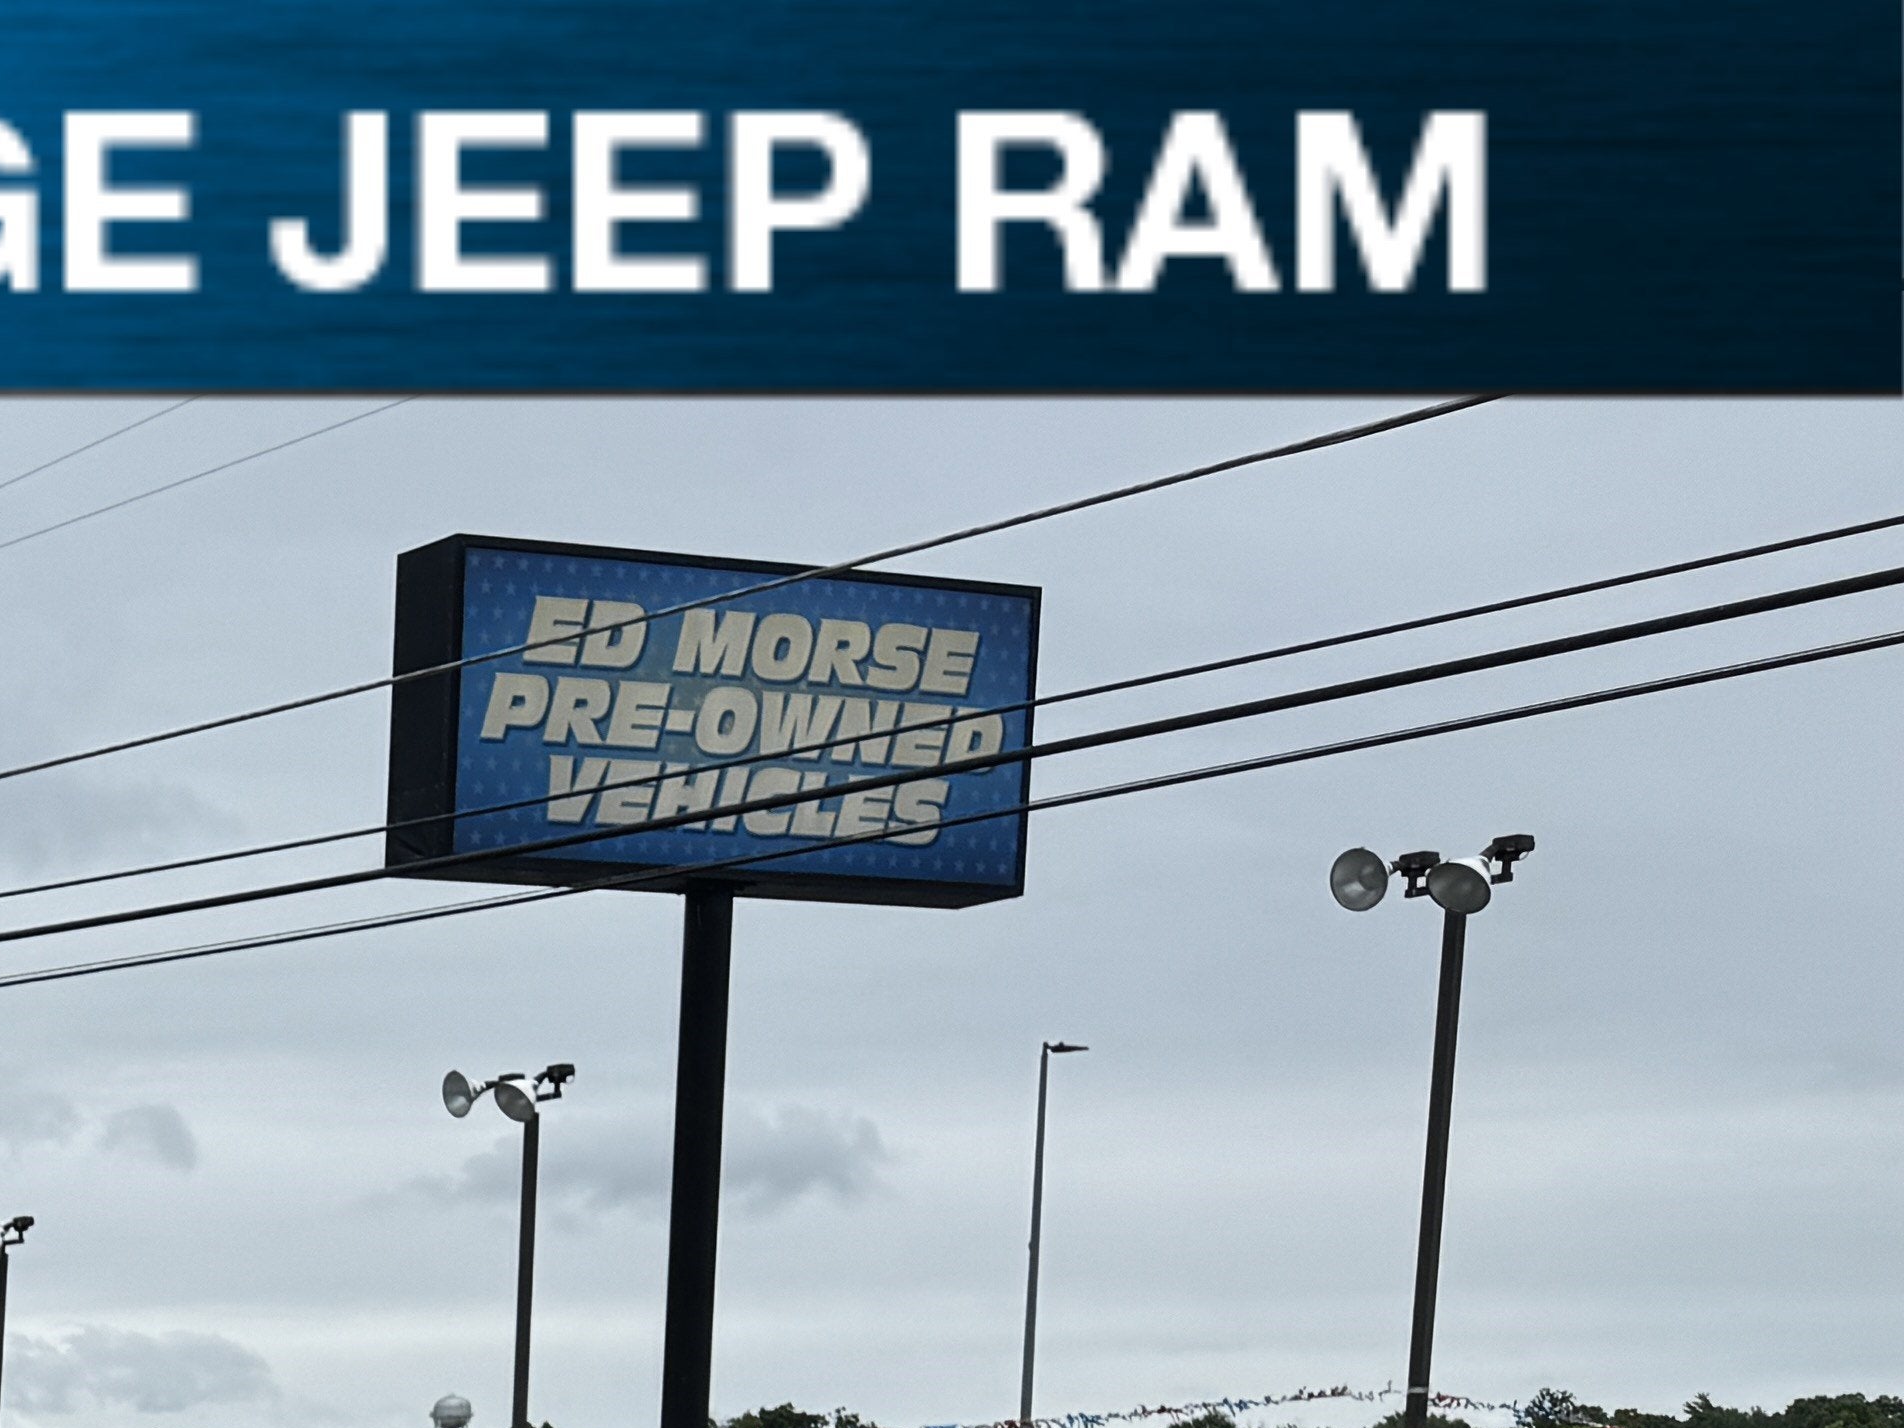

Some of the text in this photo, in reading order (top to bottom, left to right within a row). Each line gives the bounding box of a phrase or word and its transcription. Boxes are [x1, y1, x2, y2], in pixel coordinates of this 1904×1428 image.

[522, 595, 981, 697] ED MORSE
[479, 671, 1005, 775] PRE-OWNED
[546, 754, 950, 848] VEHICLES
